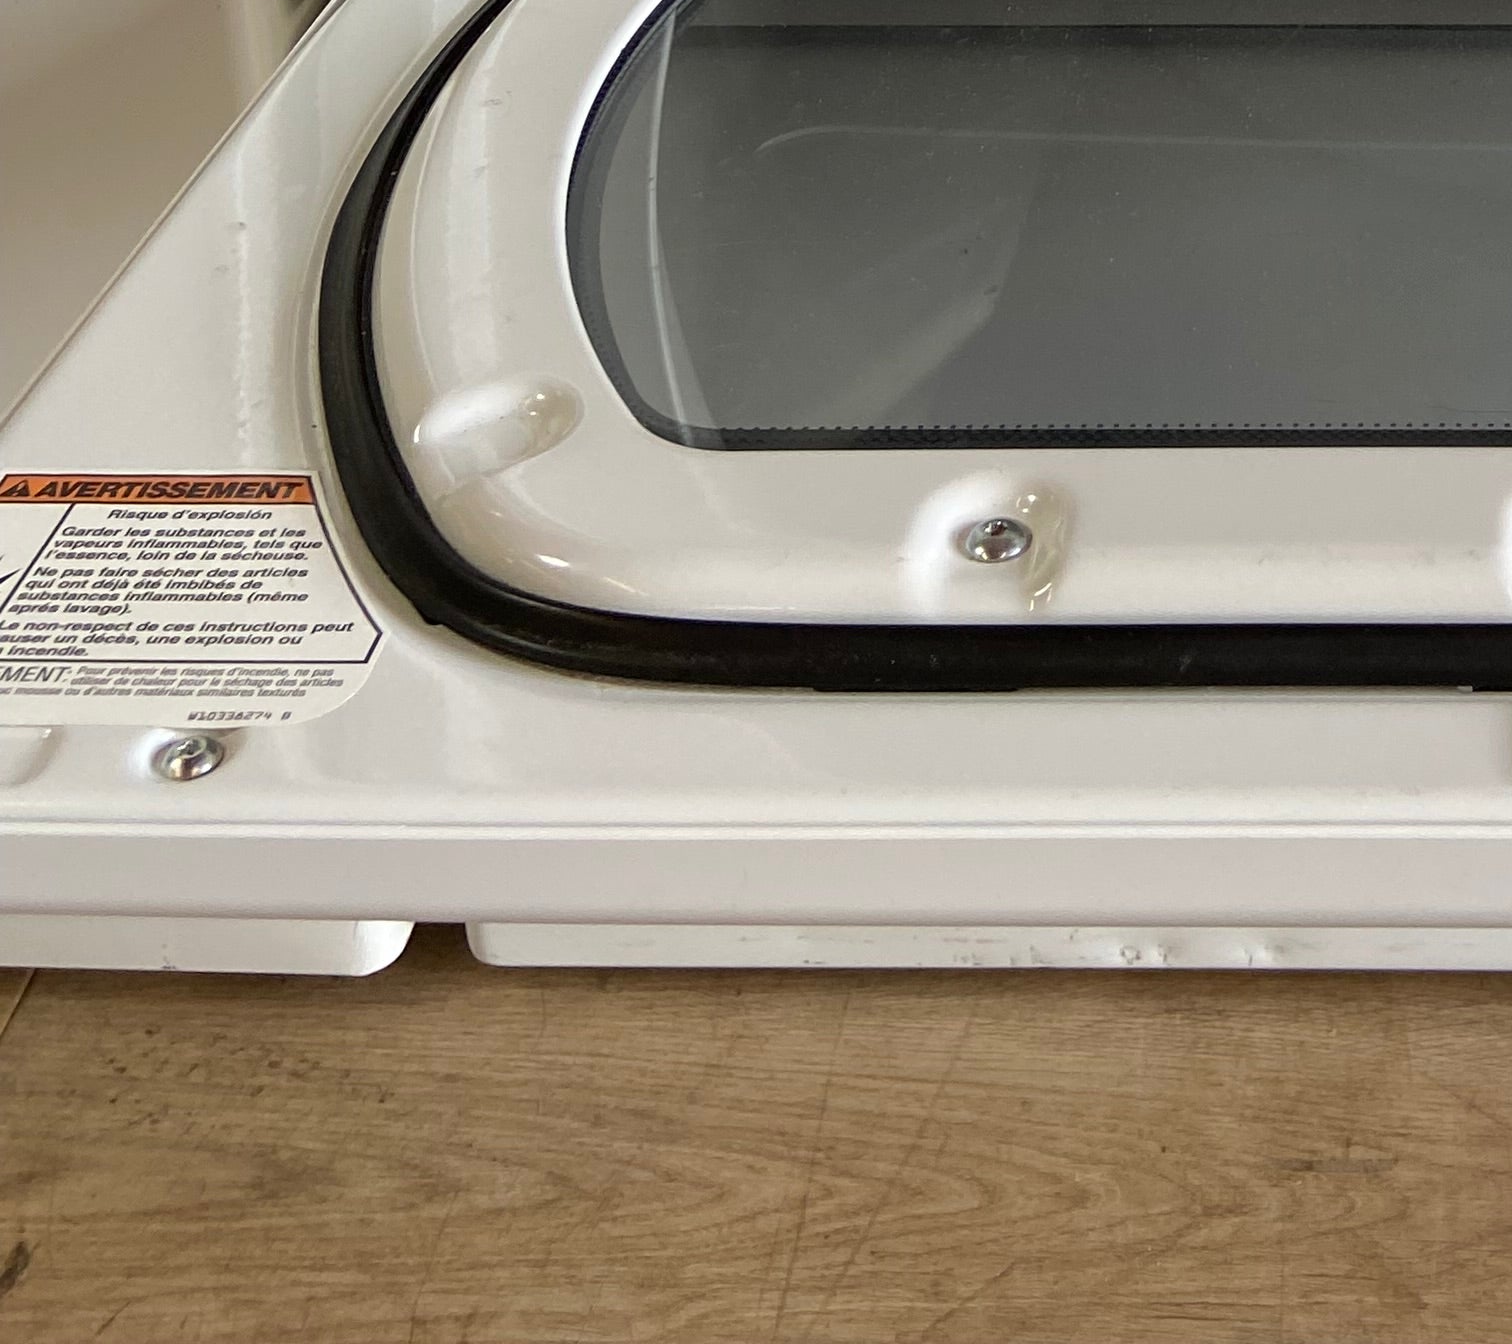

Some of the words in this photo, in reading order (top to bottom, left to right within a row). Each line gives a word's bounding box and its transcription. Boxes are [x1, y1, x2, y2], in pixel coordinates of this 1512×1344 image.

[35, 480, 303, 500] AVERTISSEMENT
[107, 509, 169, 521] Risque
[61, 526, 123, 537] Garder
[124, 527, 152, 537] les
[154, 527, 255, 538] substances
[258, 528, 277, 538] et
[279, 528, 306, 538] les
[54, 540, 124, 550] vapeurs
[126, 538, 248, 552] inflammables,
[253, 539, 286, 549] tels
[289, 539, 323, 551] que
[44, 549, 132, 562] l'essence,
[136, 550, 171, 561] loin
[174, 550, 197, 561] de
[199, 550, 218, 561] la
[220, 550, 308, 561] sécheuse.
[32, 566, 59, 577] Ne
[59, 569, 95, 579] pas
[98, 566, 139, 577] faire
[141, 567, 204, 578] sécher
[206, 568, 239, 578] des
[242, 567, 309, 578] articles
[24, 578, 57, 591] qui
[57, 580, 89, 589] ont
[91, 578, 130, 592] déjà
[132, 578, 162, 590] été
[164, 579, 236, 590] imbibés
[239, 579, 263, 590] de
[16, 590, 121, 602] substances
[122, 591, 244, 602] inflammables
[247, 591, 309, 603] (même
[62, 603, 132, 616] lavage).
